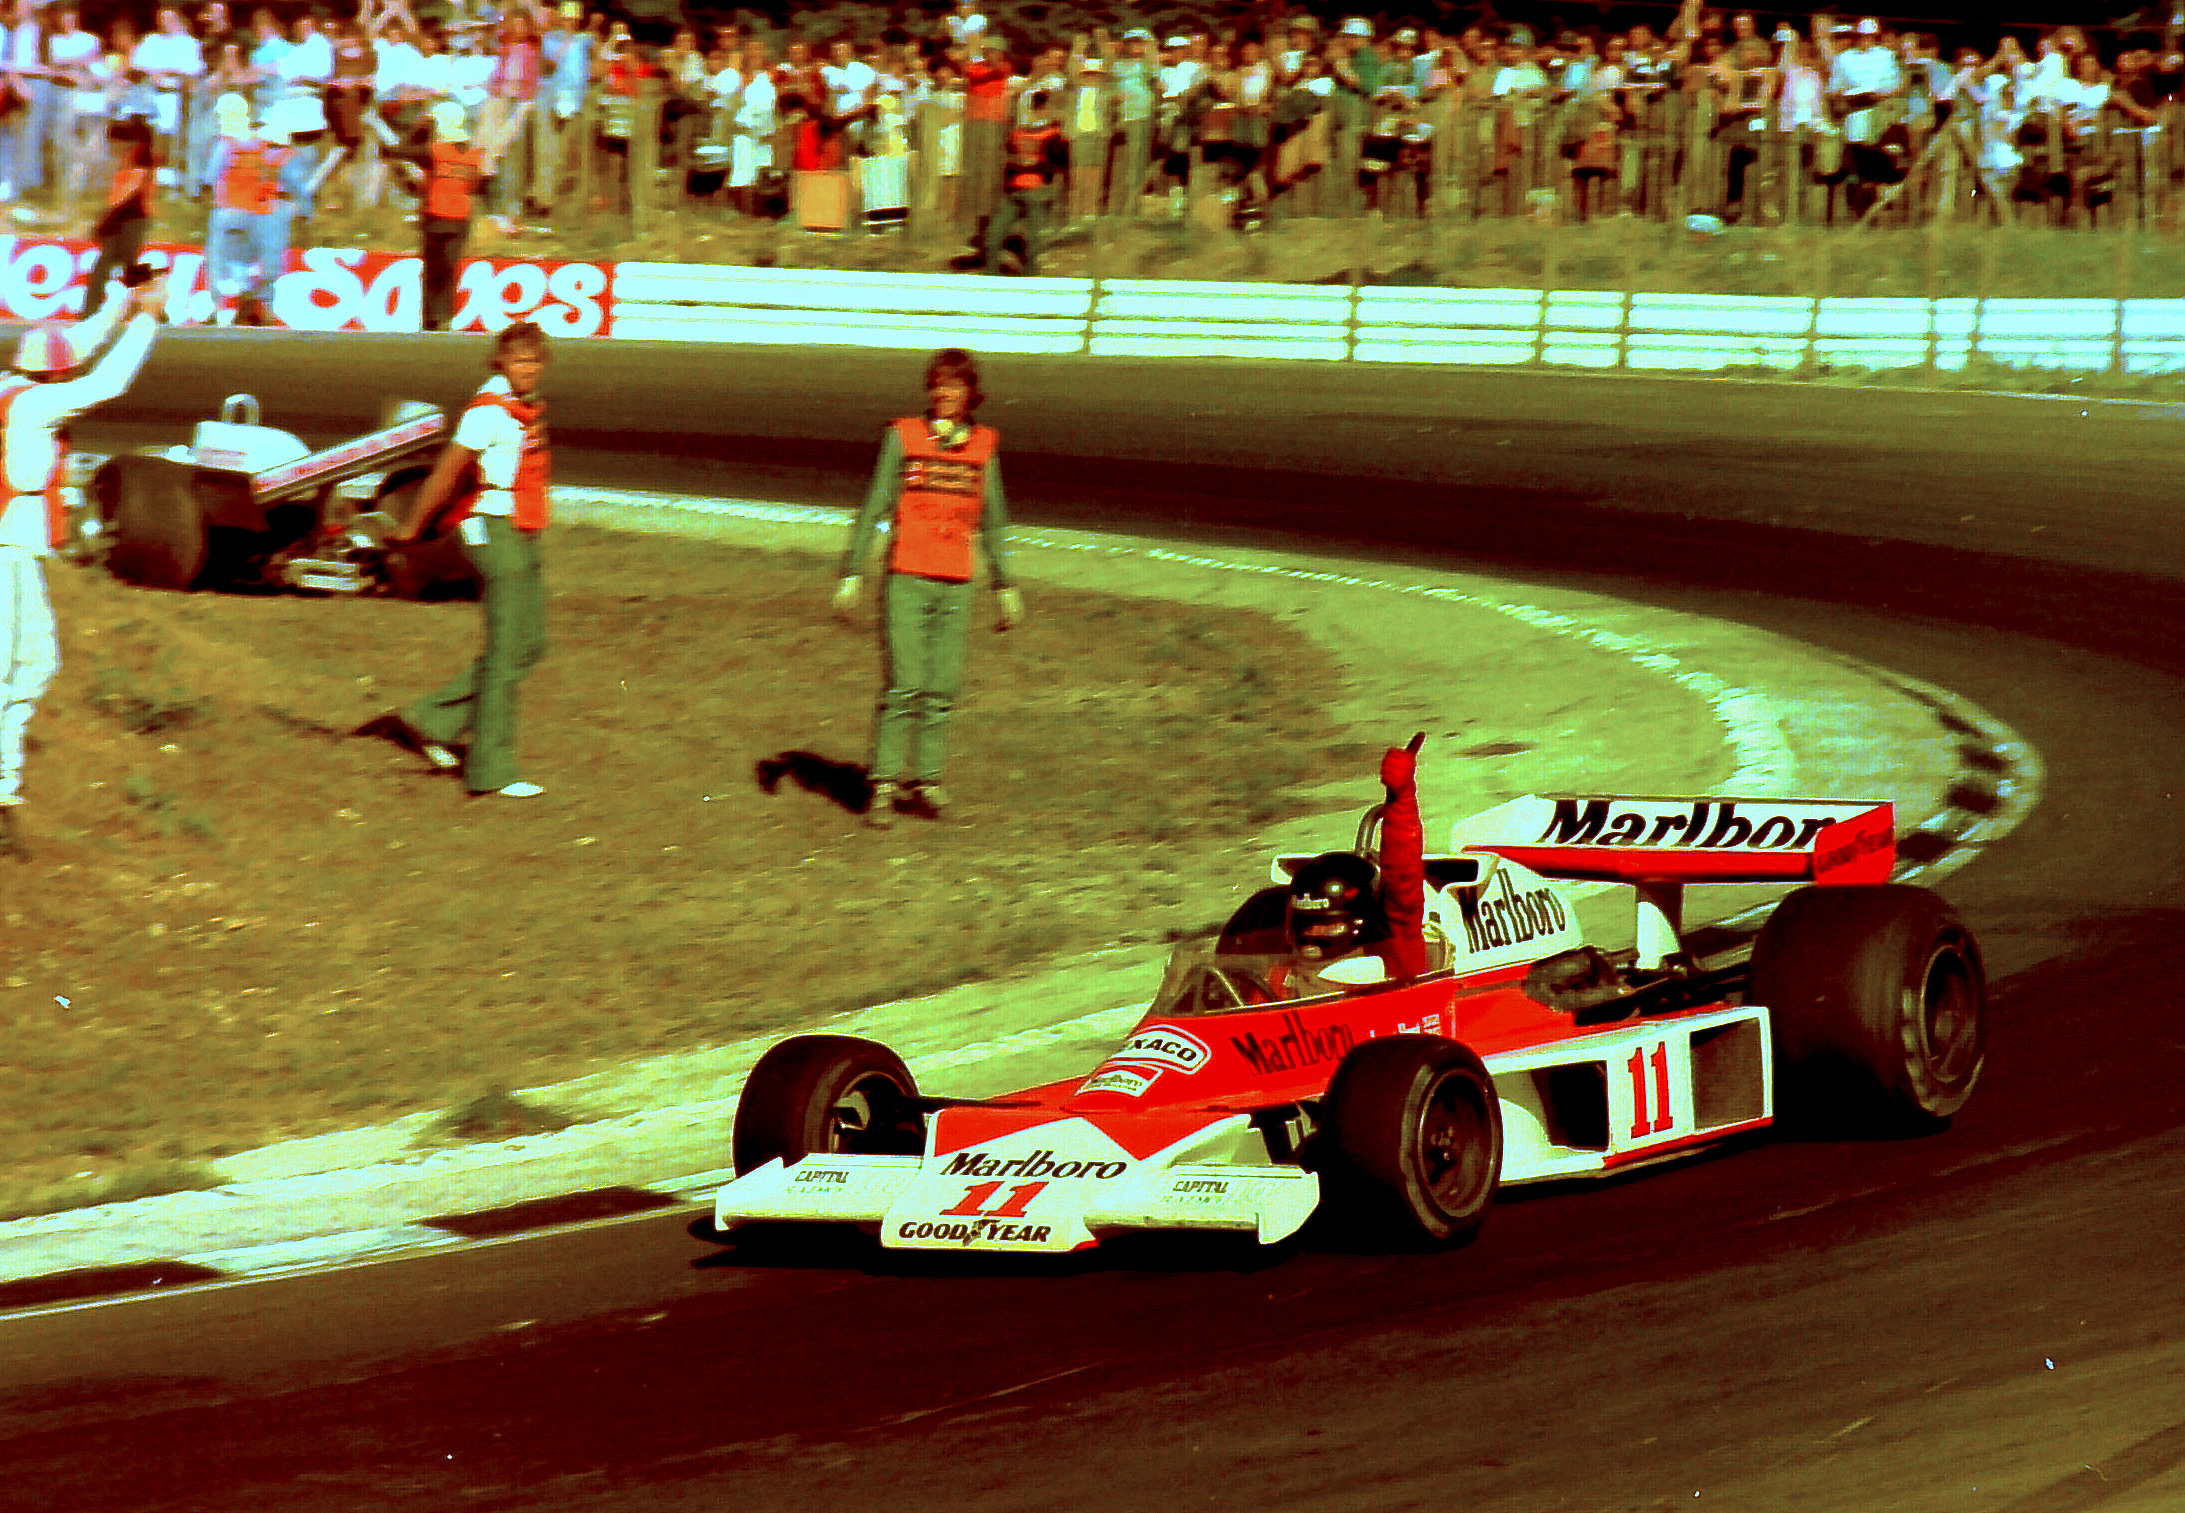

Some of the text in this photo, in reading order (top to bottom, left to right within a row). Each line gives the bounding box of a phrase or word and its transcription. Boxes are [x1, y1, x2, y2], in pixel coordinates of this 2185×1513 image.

[1535, 800, 1837, 850] Marlbor
[1457, 867, 1566, 954] Marlboro
[1127, 1038, 1197, 1062] XACO
[1626, 1041, 1674, 1139] 11
[794, 1170, 850, 1184] CAPITAL
[939, 1149, 1128, 1180] Marlboro
[938, 1180, 1050, 1218] 11
[1172, 1180, 1230, 1194] CAPITAL
